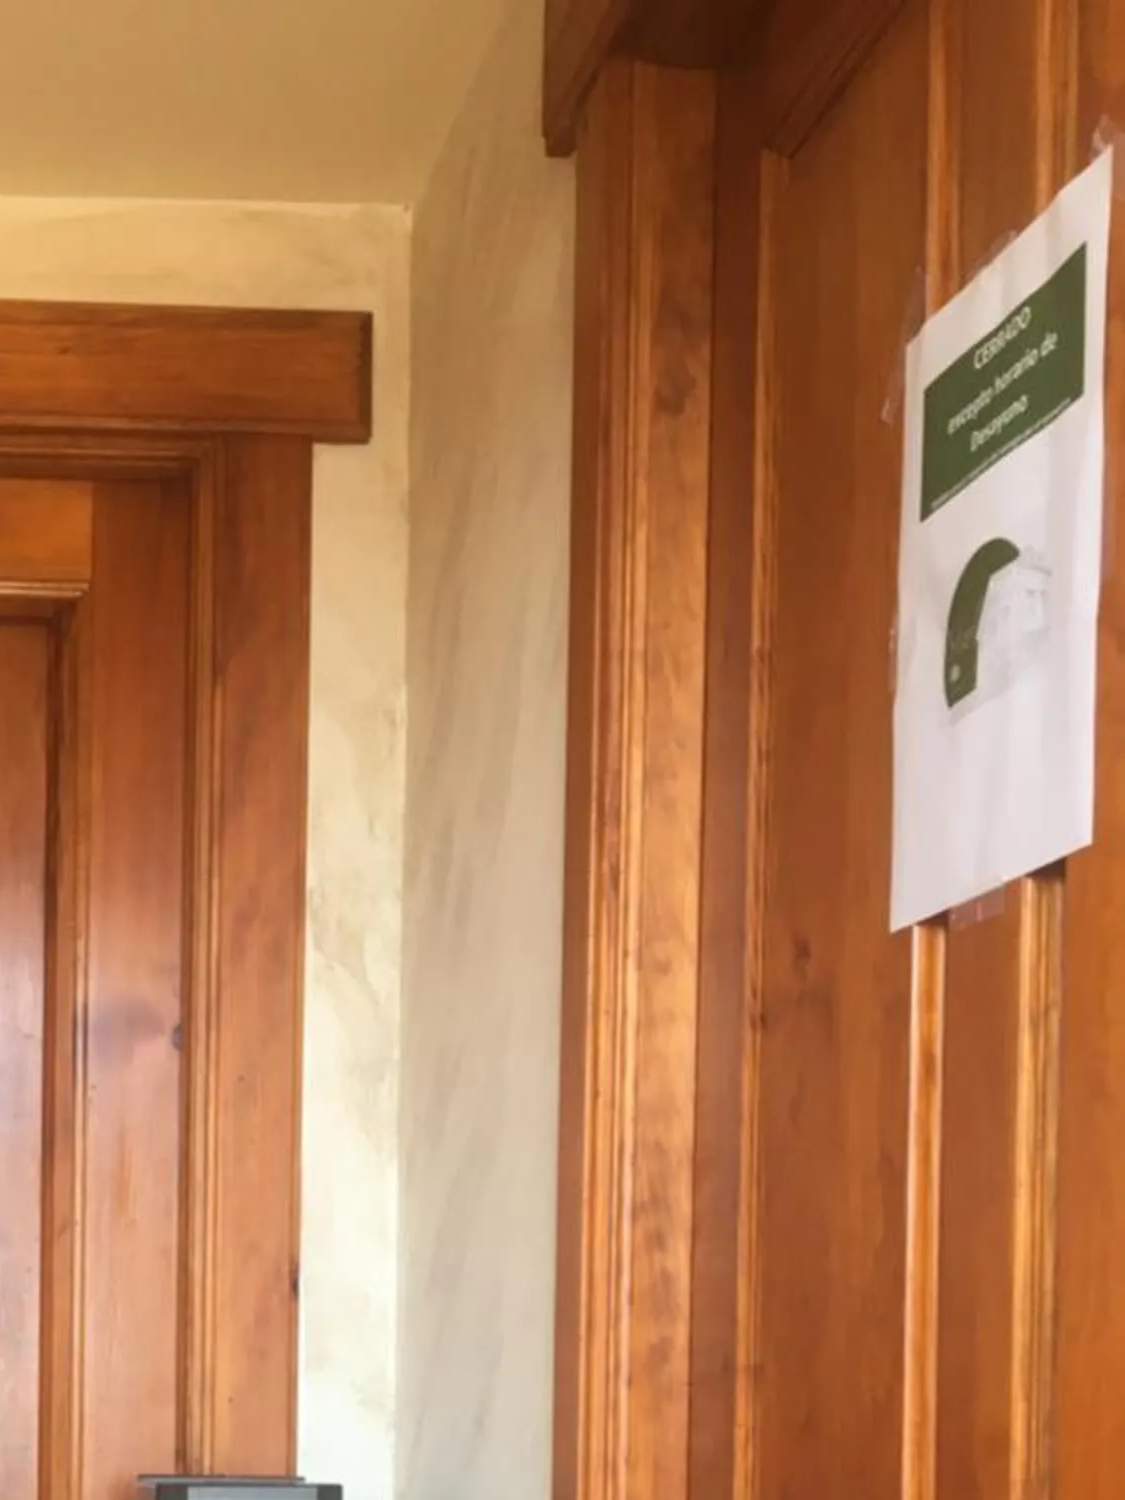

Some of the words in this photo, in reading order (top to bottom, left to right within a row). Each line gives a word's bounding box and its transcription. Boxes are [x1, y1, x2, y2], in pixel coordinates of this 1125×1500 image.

[974, 307, 1032, 369] CERRADO
[993, 347, 1040, 393] horario
[1039, 331, 1059, 358] de
